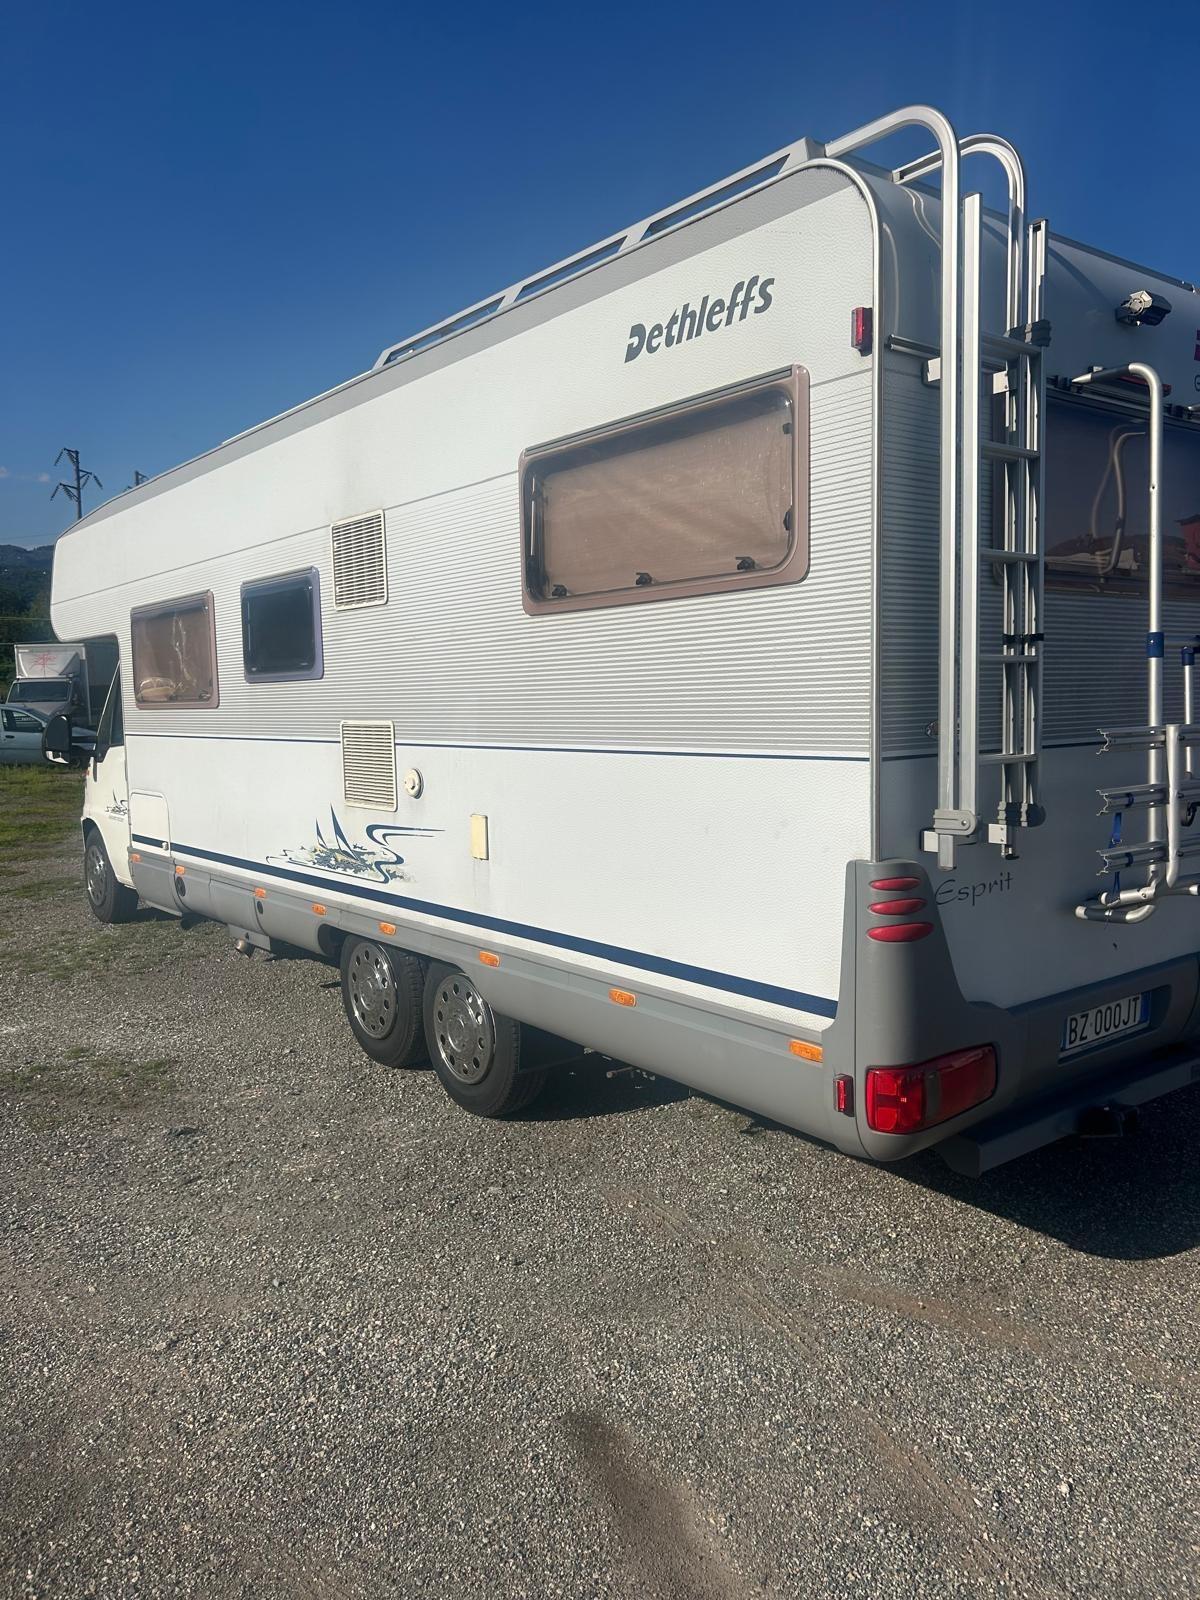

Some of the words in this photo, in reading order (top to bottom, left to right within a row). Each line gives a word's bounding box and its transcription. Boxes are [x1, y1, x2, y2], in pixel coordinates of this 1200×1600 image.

[624, 274, 775, 363] Dethleffs
[934, 871, 1013, 906] Esprit
[1069, 1012, 1089, 1045] BZ
